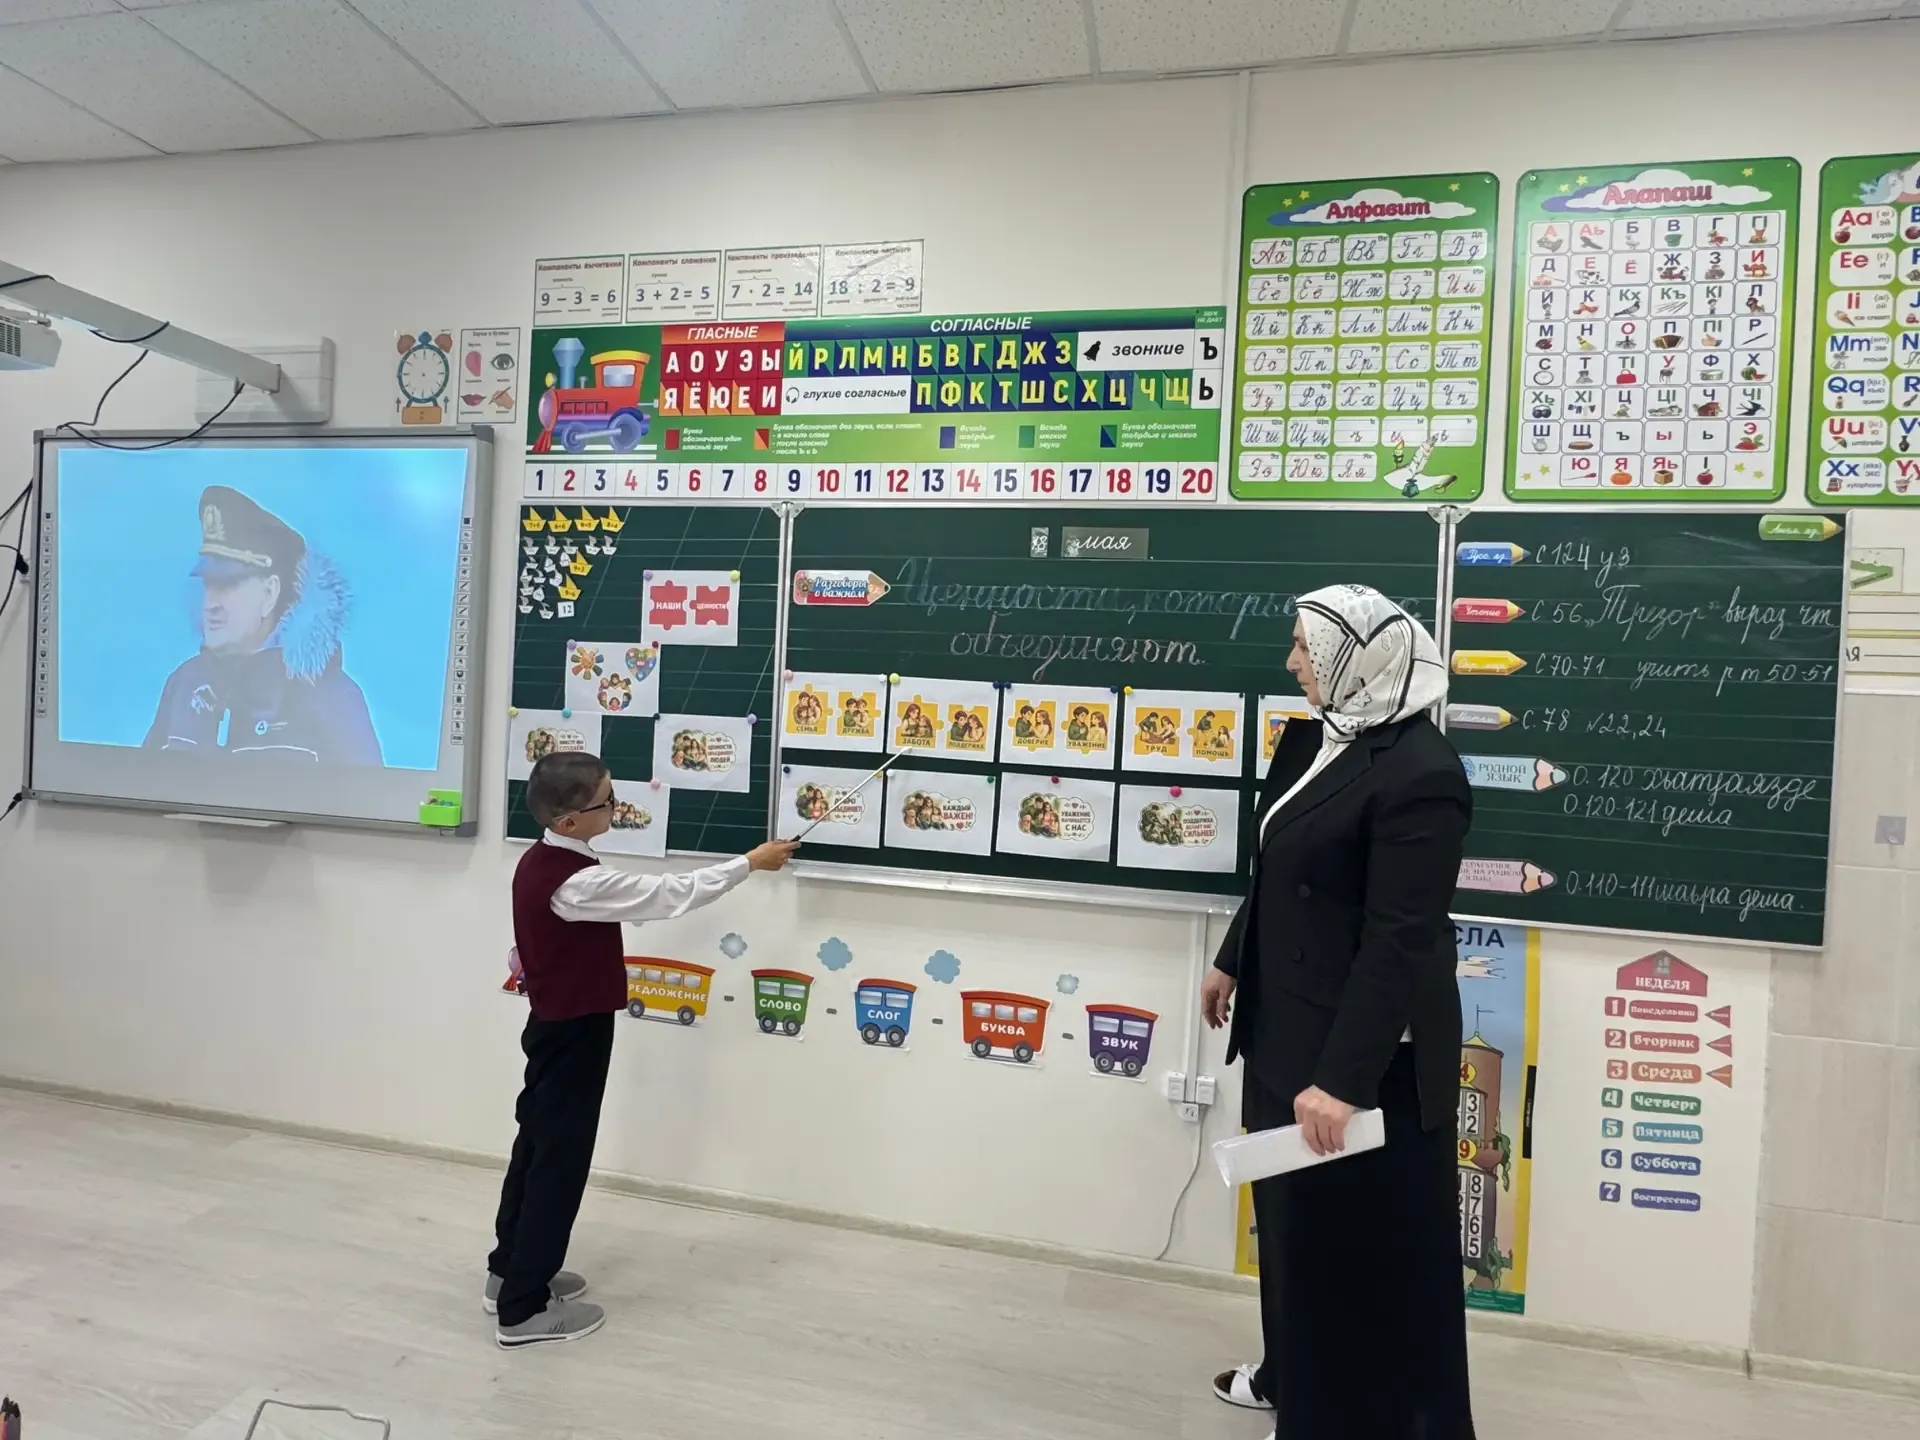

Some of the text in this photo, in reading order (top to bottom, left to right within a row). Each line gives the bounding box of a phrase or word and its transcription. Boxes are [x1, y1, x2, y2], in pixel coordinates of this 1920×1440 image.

[1603, 184, 1713, 205] Алапаш
[1326, 201, 1430, 223] Алфавит
[1838, 210, 1872, 226] Aa
[1544, 225, 1557, 236] А
[1627, 222, 1639, 234] Б
[1667, 220, 1680, 232] В
[1712, 218, 1723, 230] Г
[1840, 252, 1869, 268] Ee
[541, 290, 616, 306] 9 3 6
[636, 286, 710, 302] 3 2 5
[687, 326, 759, 340] ГЛАСНЫЕ
[931, 317, 1033, 333] СОГЛАСНЫЕ
[1830, 335, 1871, 352] Mm
[665, 341, 1185, 373] А О У Э Ы Й Р Л М Н Б В Г Д Ж З звонкие
[1827, 376, 1865, 396] Qq
[664, 382, 907, 409] Я Ё Ю Е И глухие согласные
[1829, 418, 1864, 435] Uu
[1826, 460, 1860, 477] Xx
[536, 469, 1213, 493] 1 2 3 4 5 6 7 8 9 10 11 12 13 14 15 16 17 18 19 20
[1076, 536, 1132, 550] мая
[1552, 542, 1590, 570] 124
[815, 577, 867, 590] Разговоры
[823, 589, 865, 598] важном
[563, 606, 572, 614] 12
[656, 601, 682, 609] НАШИ
[842, 727, 869, 735] ДРУЖБА
[902, 738, 931, 746] ЗАБОТА
[1067, 741, 1105, 749] УВАЖЕНИЕ
[1145, 744, 1168, 753] ТРУД
[1479, 763, 1527, 774] РОДНОЙ
[1486, 774, 1522, 783] ЯЗЫК
[943, 811, 974, 821] ВАЖЕН!
[1183, 829, 1215, 838] СИЛЬНЕЕ!
[1455, 926, 1505, 949] СЛА
[1635, 976, 1690, 991] НЕДЕЛЯ
[628, 983, 708, 1002] РЕДЛОЖЕНИЕ
[759, 998, 802, 1012] СЛОВО
[1610, 1000, 1618, 1014] 1
[867, 1009, 901, 1022] СЛОГ
[981, 1022, 1026, 1036] БУКВА
[1102, 1036, 1139, 1050] ЗВУК
[1608, 1031, 1695, 1049] 2 Вторник
[1610, 1062, 1624, 1078] 3
[1638, 1064, 1694, 1080] Среда
[1468, 1094, 1478, 1112] 3
[1604, 1090, 1698, 1111] 4 Четверг
[1466, 1115, 1477, 1133] 2
[1606, 1120, 1699, 1140] 5 Пятница
[1605, 1150, 1697, 1172] 6 Суббота
[1604, 1184, 1616, 1200] 7
